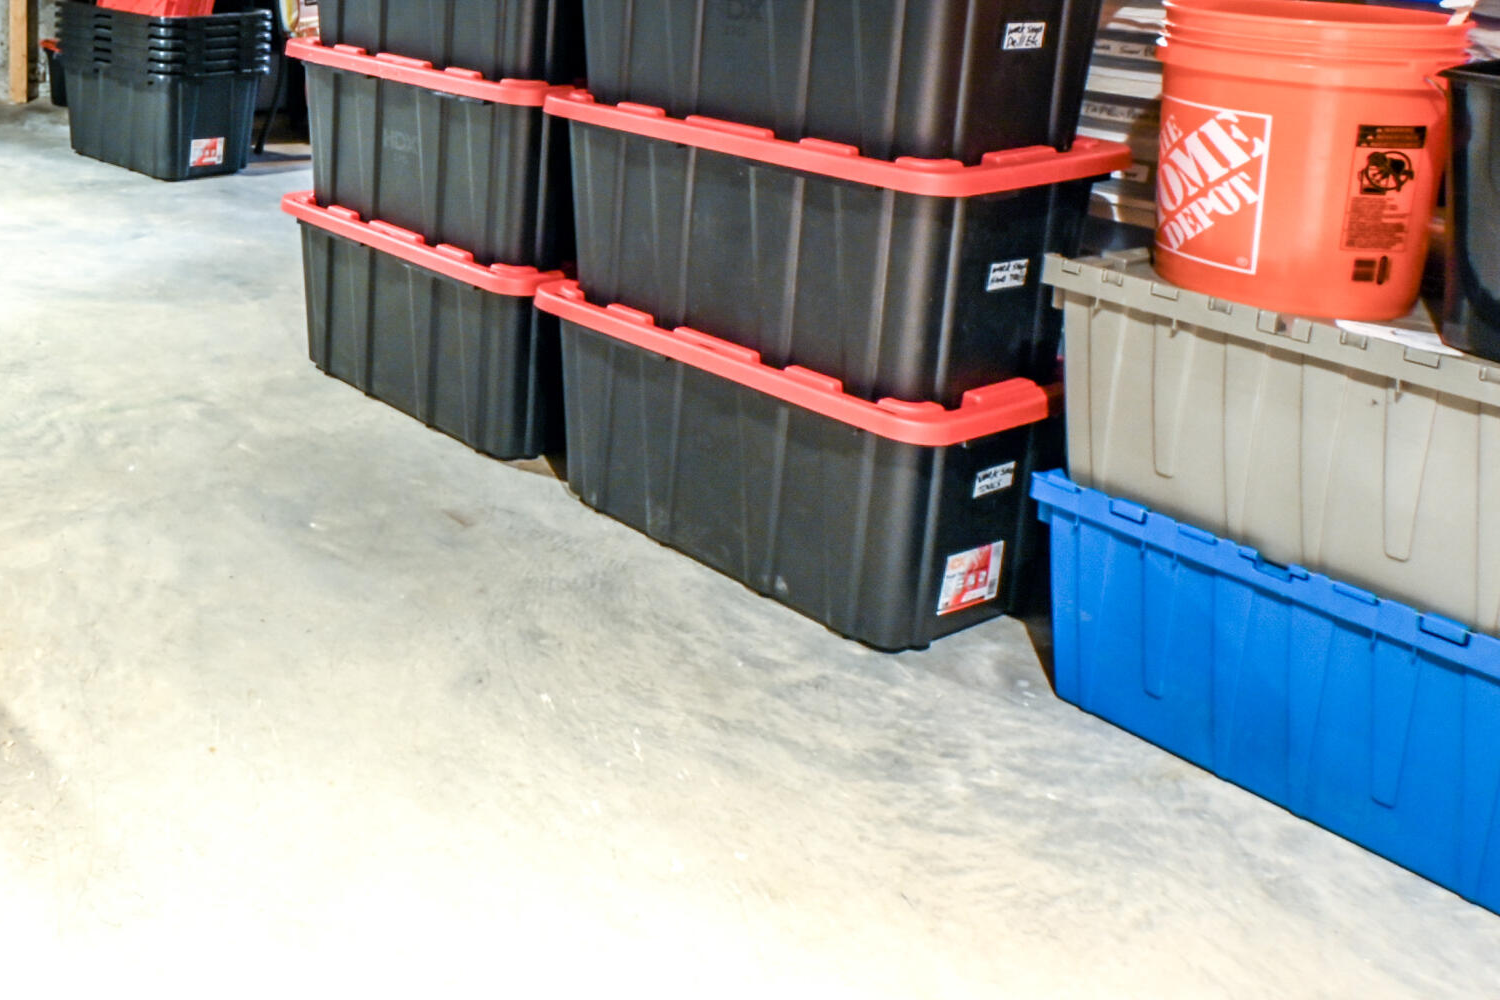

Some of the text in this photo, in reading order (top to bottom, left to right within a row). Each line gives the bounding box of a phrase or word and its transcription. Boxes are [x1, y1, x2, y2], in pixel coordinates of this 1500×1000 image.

[1157, 111, 1267, 226] OME
[1159, 114, 1184, 156] HE
[1163, 171, 1260, 251] DEPOT
